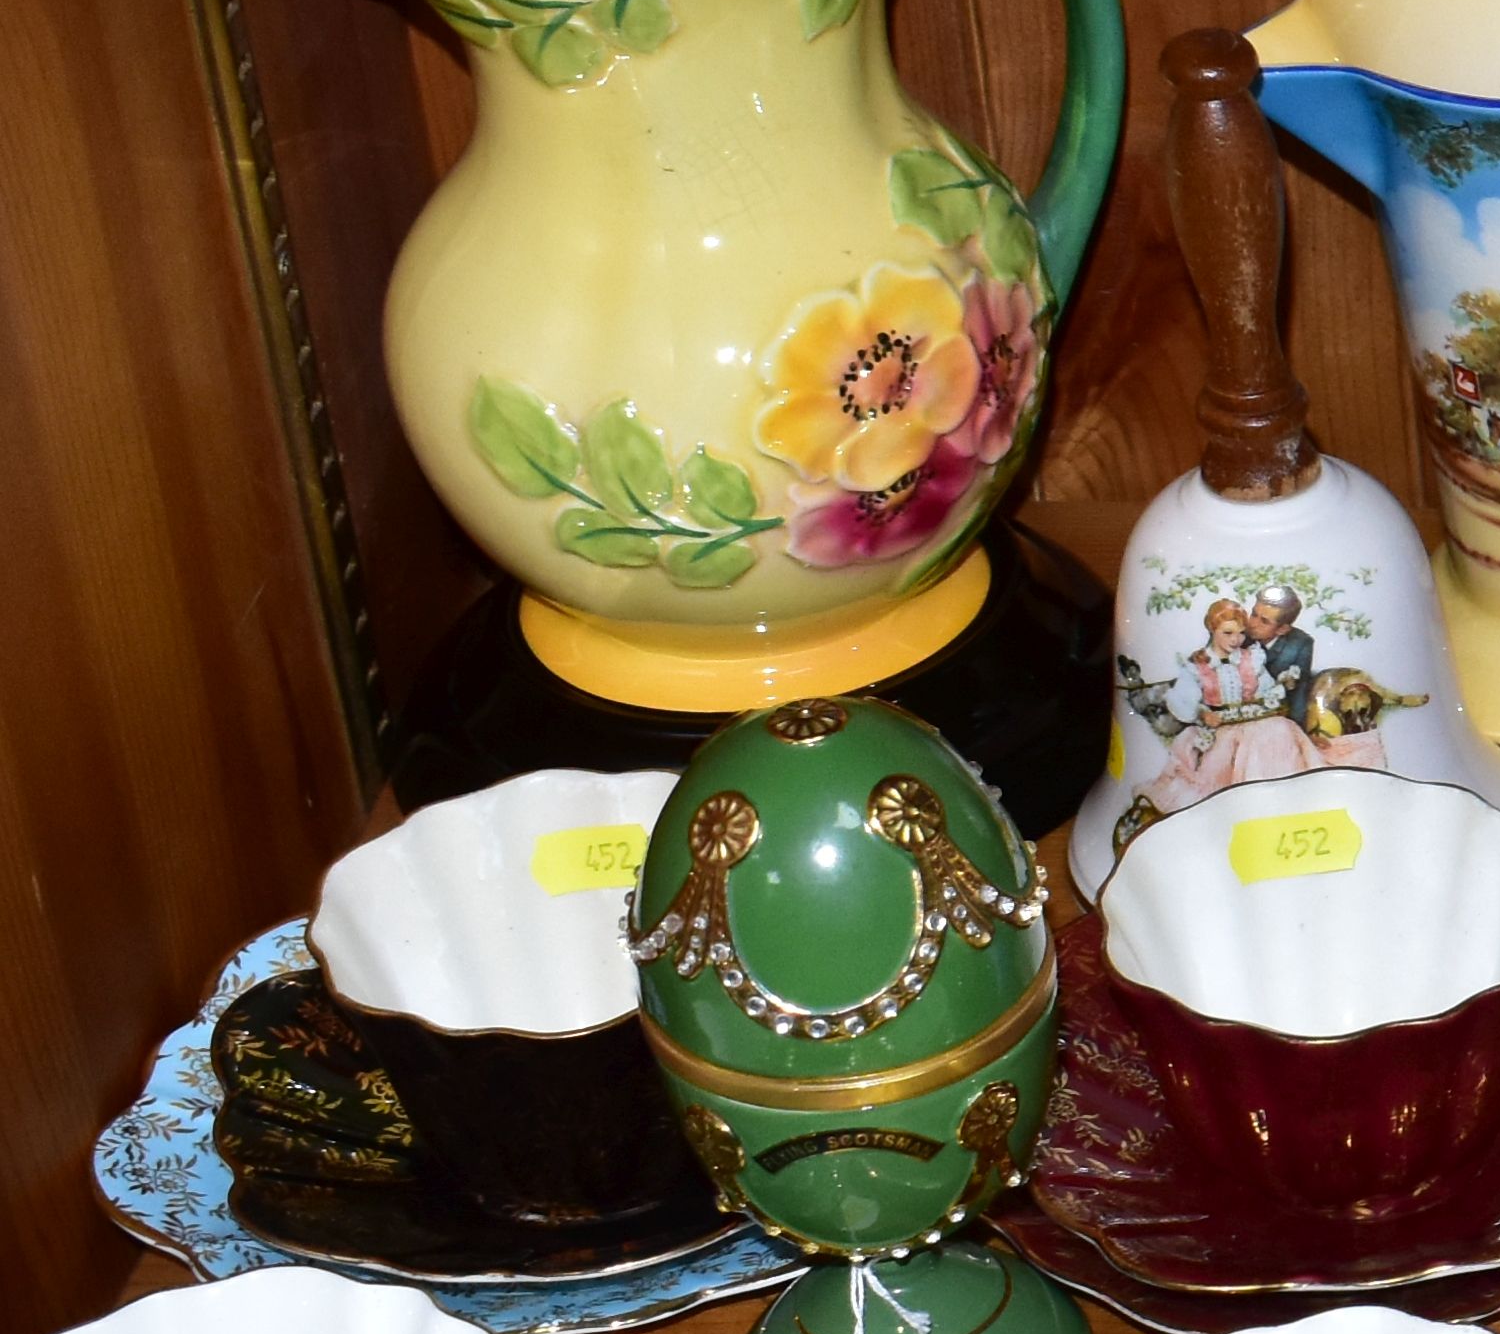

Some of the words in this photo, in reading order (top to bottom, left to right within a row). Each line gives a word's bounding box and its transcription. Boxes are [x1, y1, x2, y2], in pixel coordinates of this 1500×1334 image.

[585, 841, 635, 872] 452
[1276, 826, 1331, 860] 452
[826, 1132, 934, 1158] SCOTSMAN
